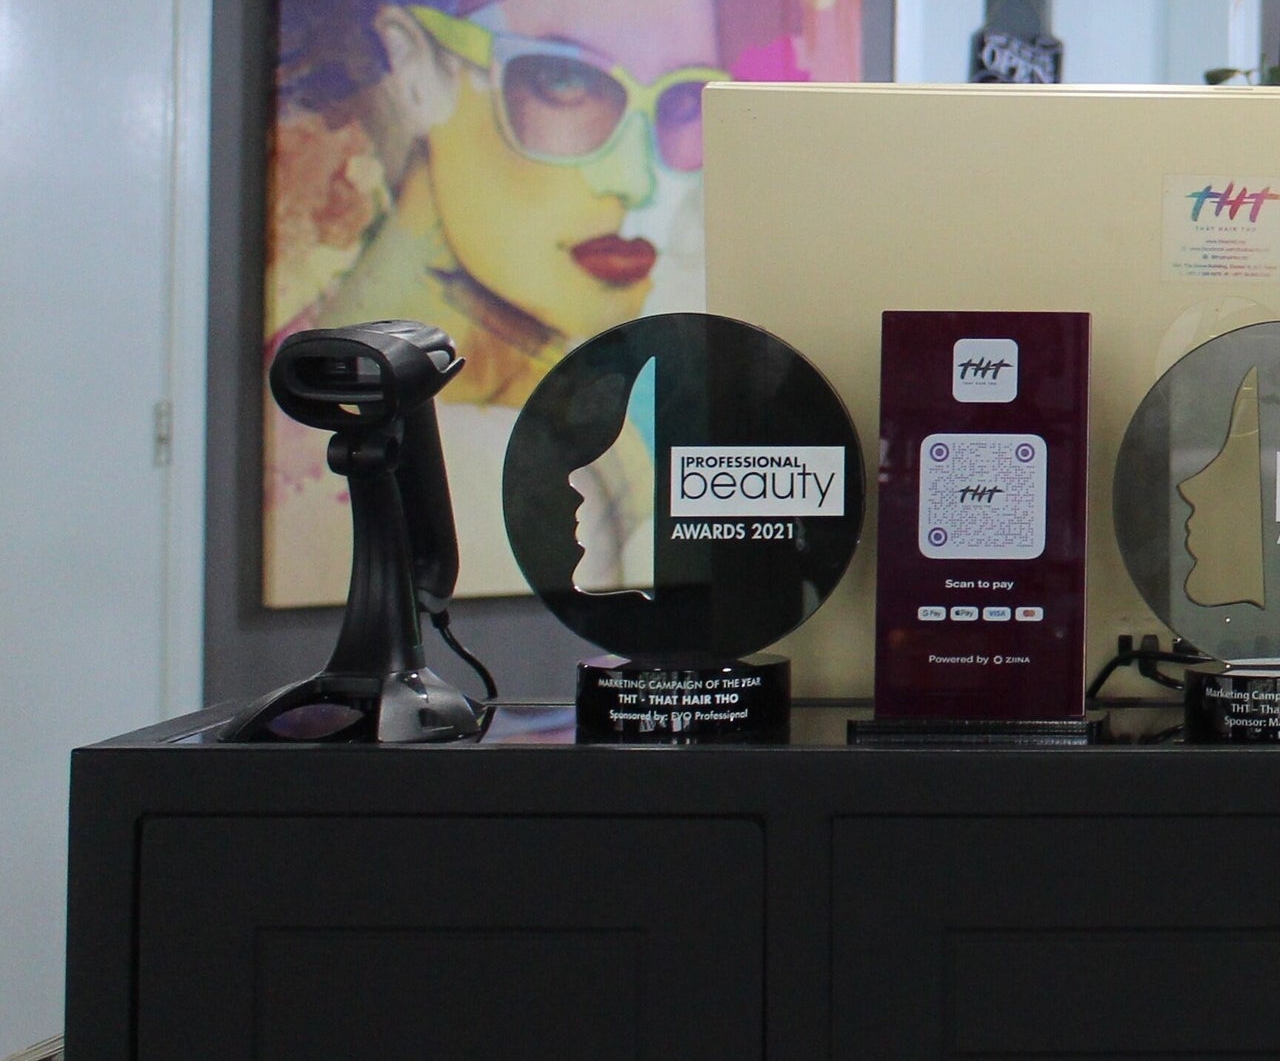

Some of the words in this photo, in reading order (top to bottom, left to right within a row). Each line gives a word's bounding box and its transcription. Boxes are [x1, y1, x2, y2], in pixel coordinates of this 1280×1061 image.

[686, 456, 803, 469] PROFESSIONAL
[680, 456, 836, 508] beauty
[671, 522, 746, 540] AWARDS
[751, 522, 794, 540] 2021
[945, 579, 975, 589] Scan
[978, 579, 990, 589] to
[993, 580, 1014, 591] pay
[930, 610, 942, 618] Pay
[961, 609, 974, 618] Pay
[929, 655, 974, 664] Powered
[976, 655, 990, 665] by
[1005, 656, 1031, 664] ZIINA
[598, 678, 646, 690] MARKETING
[649, 679, 702, 690] CAMPAIGN
[705, 679, 720, 689] OF
[722, 679, 740, 689] THE
[741, 676, 762, 688] YEAR
[618, 693, 638, 704] THT
[649, 695, 679, 706] THAT
[682, 694, 712, 705] HAIR
[714, 693, 739, 704] THO
[1206, 687, 1250, 702] Marketing
[1231, 703, 1250, 714] THT
[609, 709, 651, 722] Sponsored
[671, 712, 692, 721] EVO
[694, 709, 749, 722] Professional
[1224, 715, 1267, 730] Sponsor:
